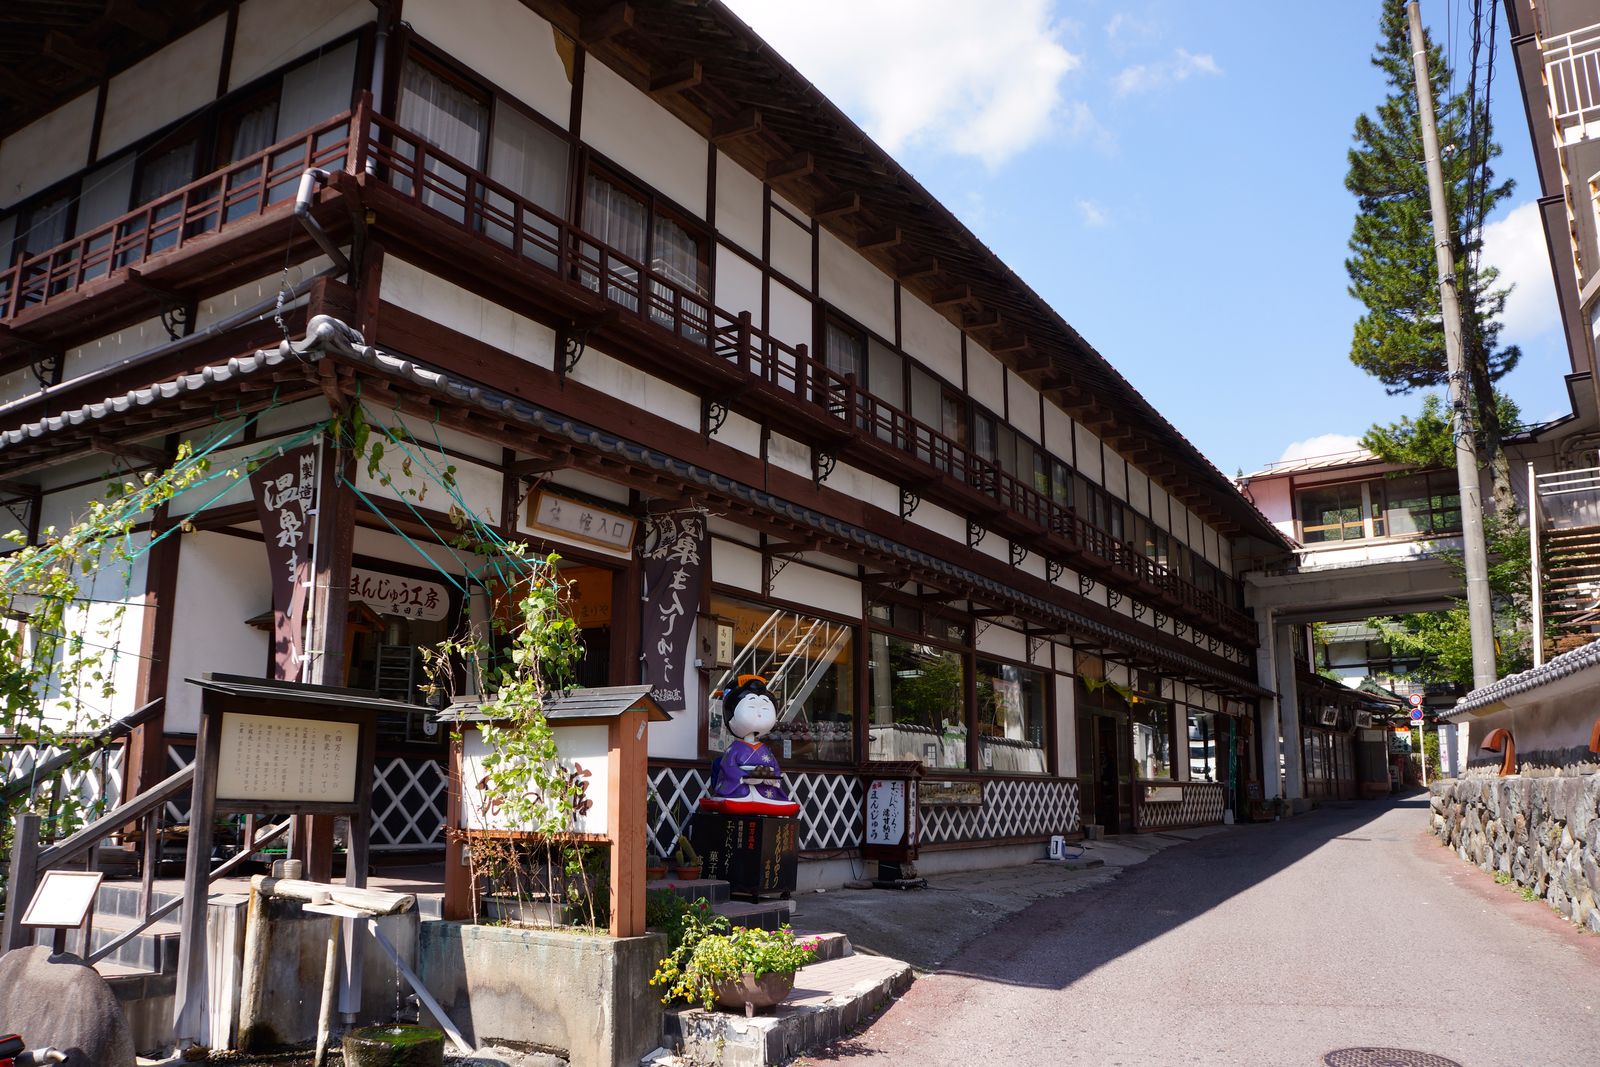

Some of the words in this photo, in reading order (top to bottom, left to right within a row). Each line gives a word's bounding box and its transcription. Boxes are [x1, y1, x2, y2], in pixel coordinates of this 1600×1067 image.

[349, 574, 440, 610] まんじゅう工房
